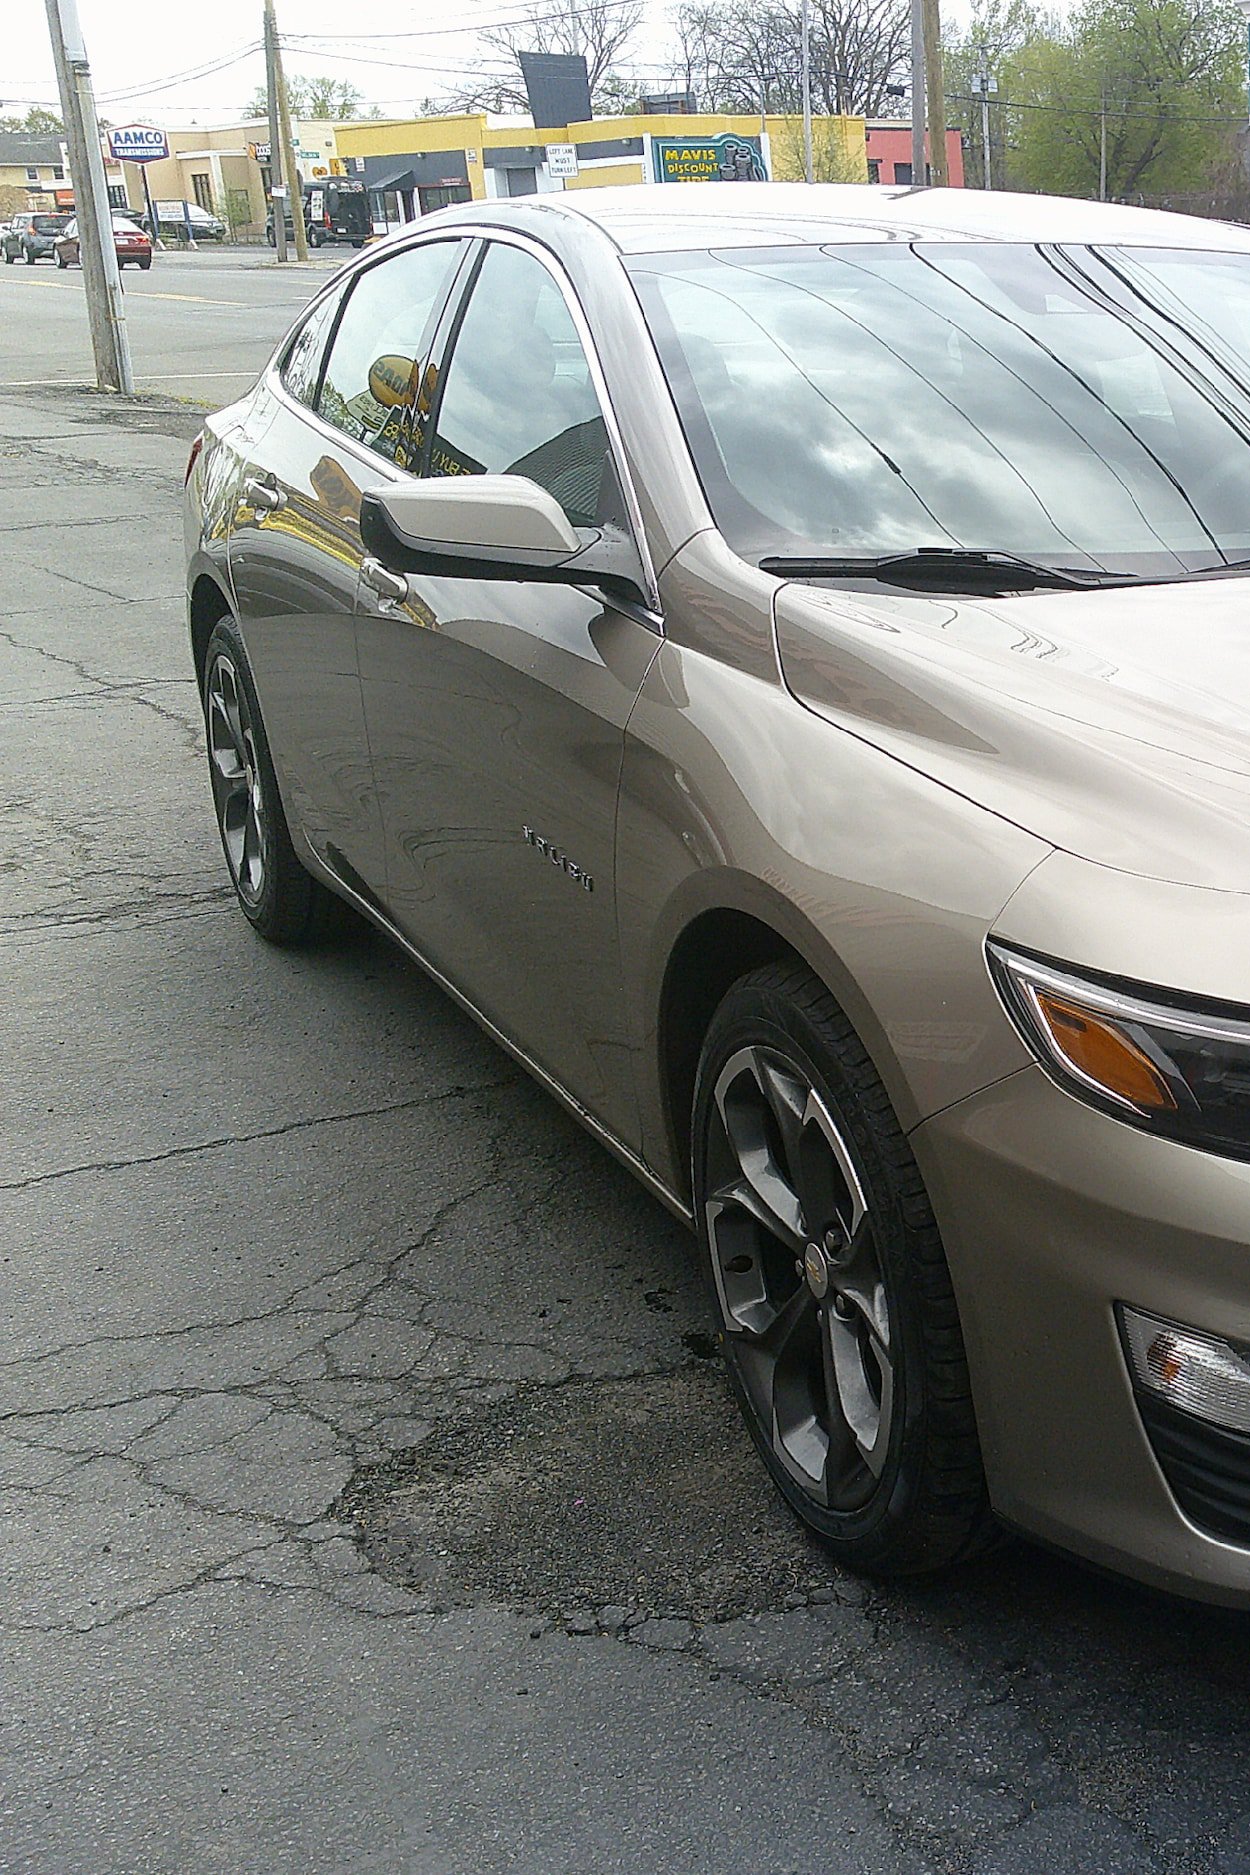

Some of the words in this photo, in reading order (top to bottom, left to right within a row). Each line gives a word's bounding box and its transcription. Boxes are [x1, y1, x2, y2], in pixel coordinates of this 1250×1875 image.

[114, 131, 163, 144] AAMCO
[664, 149, 717, 161] MAVIS
[667, 162, 719, 174] DISCOUNT
